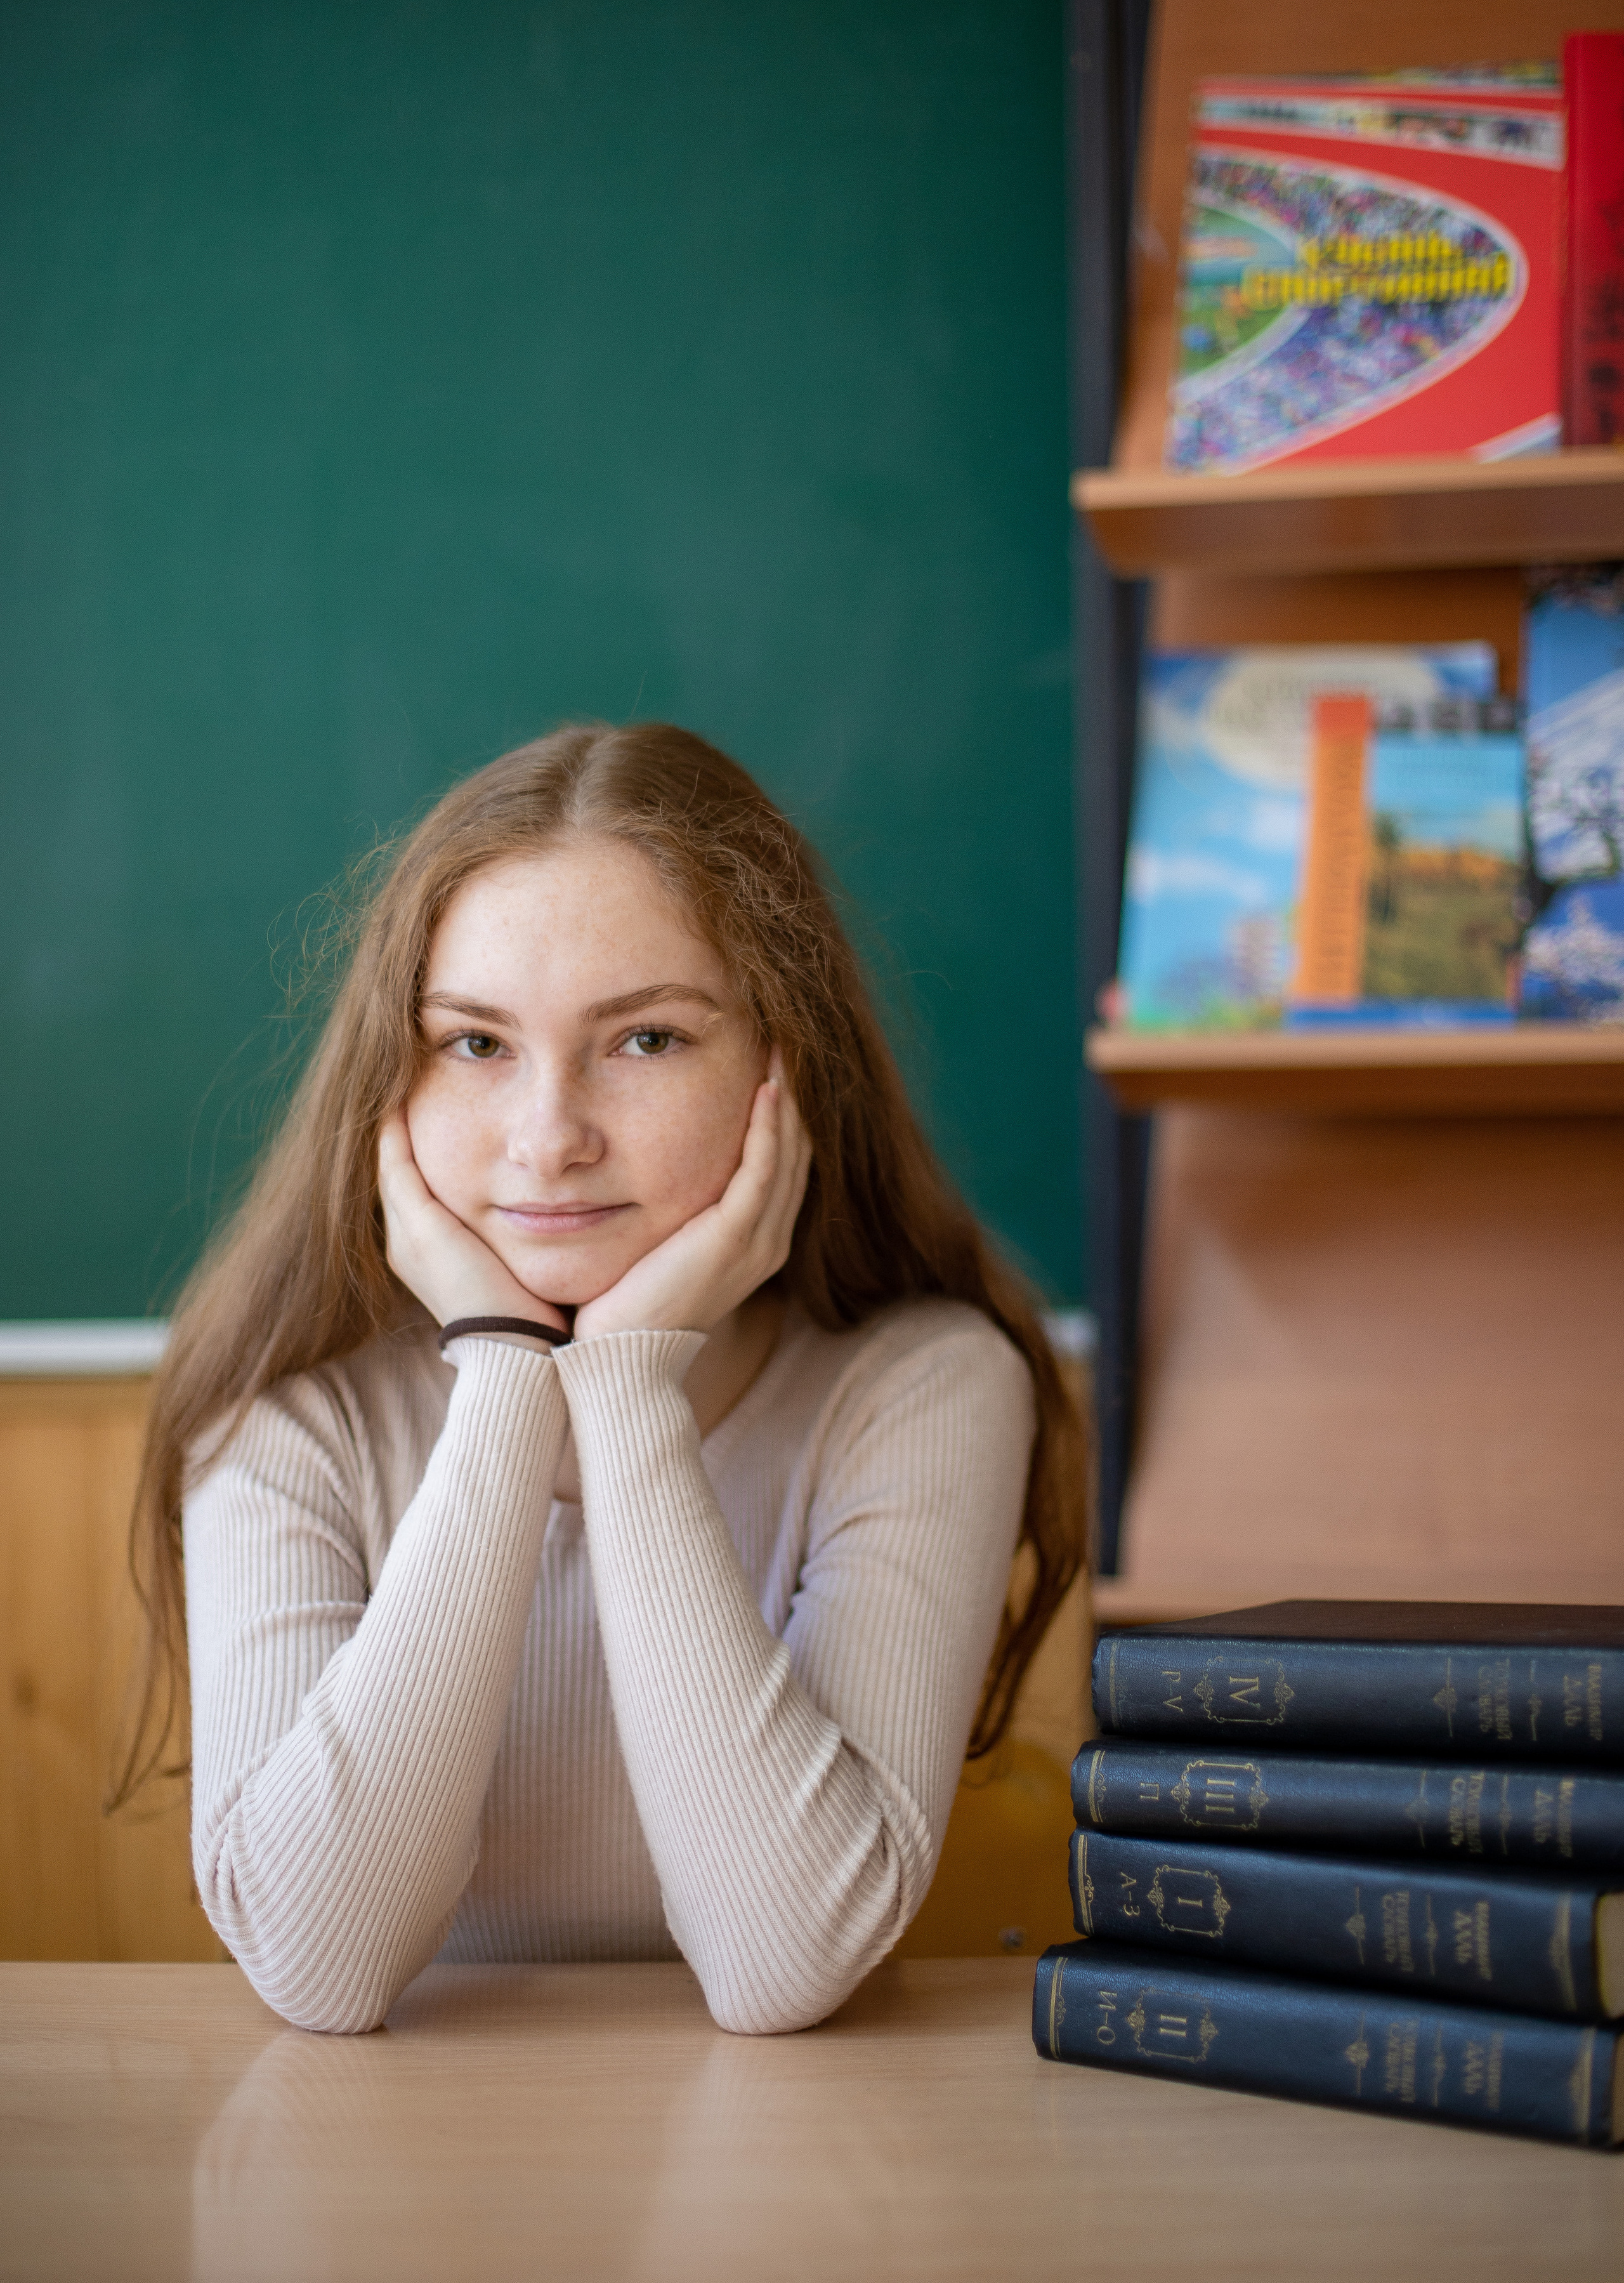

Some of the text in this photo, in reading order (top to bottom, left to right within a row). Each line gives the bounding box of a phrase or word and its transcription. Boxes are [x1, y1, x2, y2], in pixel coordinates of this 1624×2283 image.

[1228, 1676, 1260, 1709] IV
[1140, 1782, 1159, 1800] П
[1205, 1779, 1235, 1813] III
[1177, 1896, 1203, 1908] I
[1159, 2014, 1188, 2037] II
